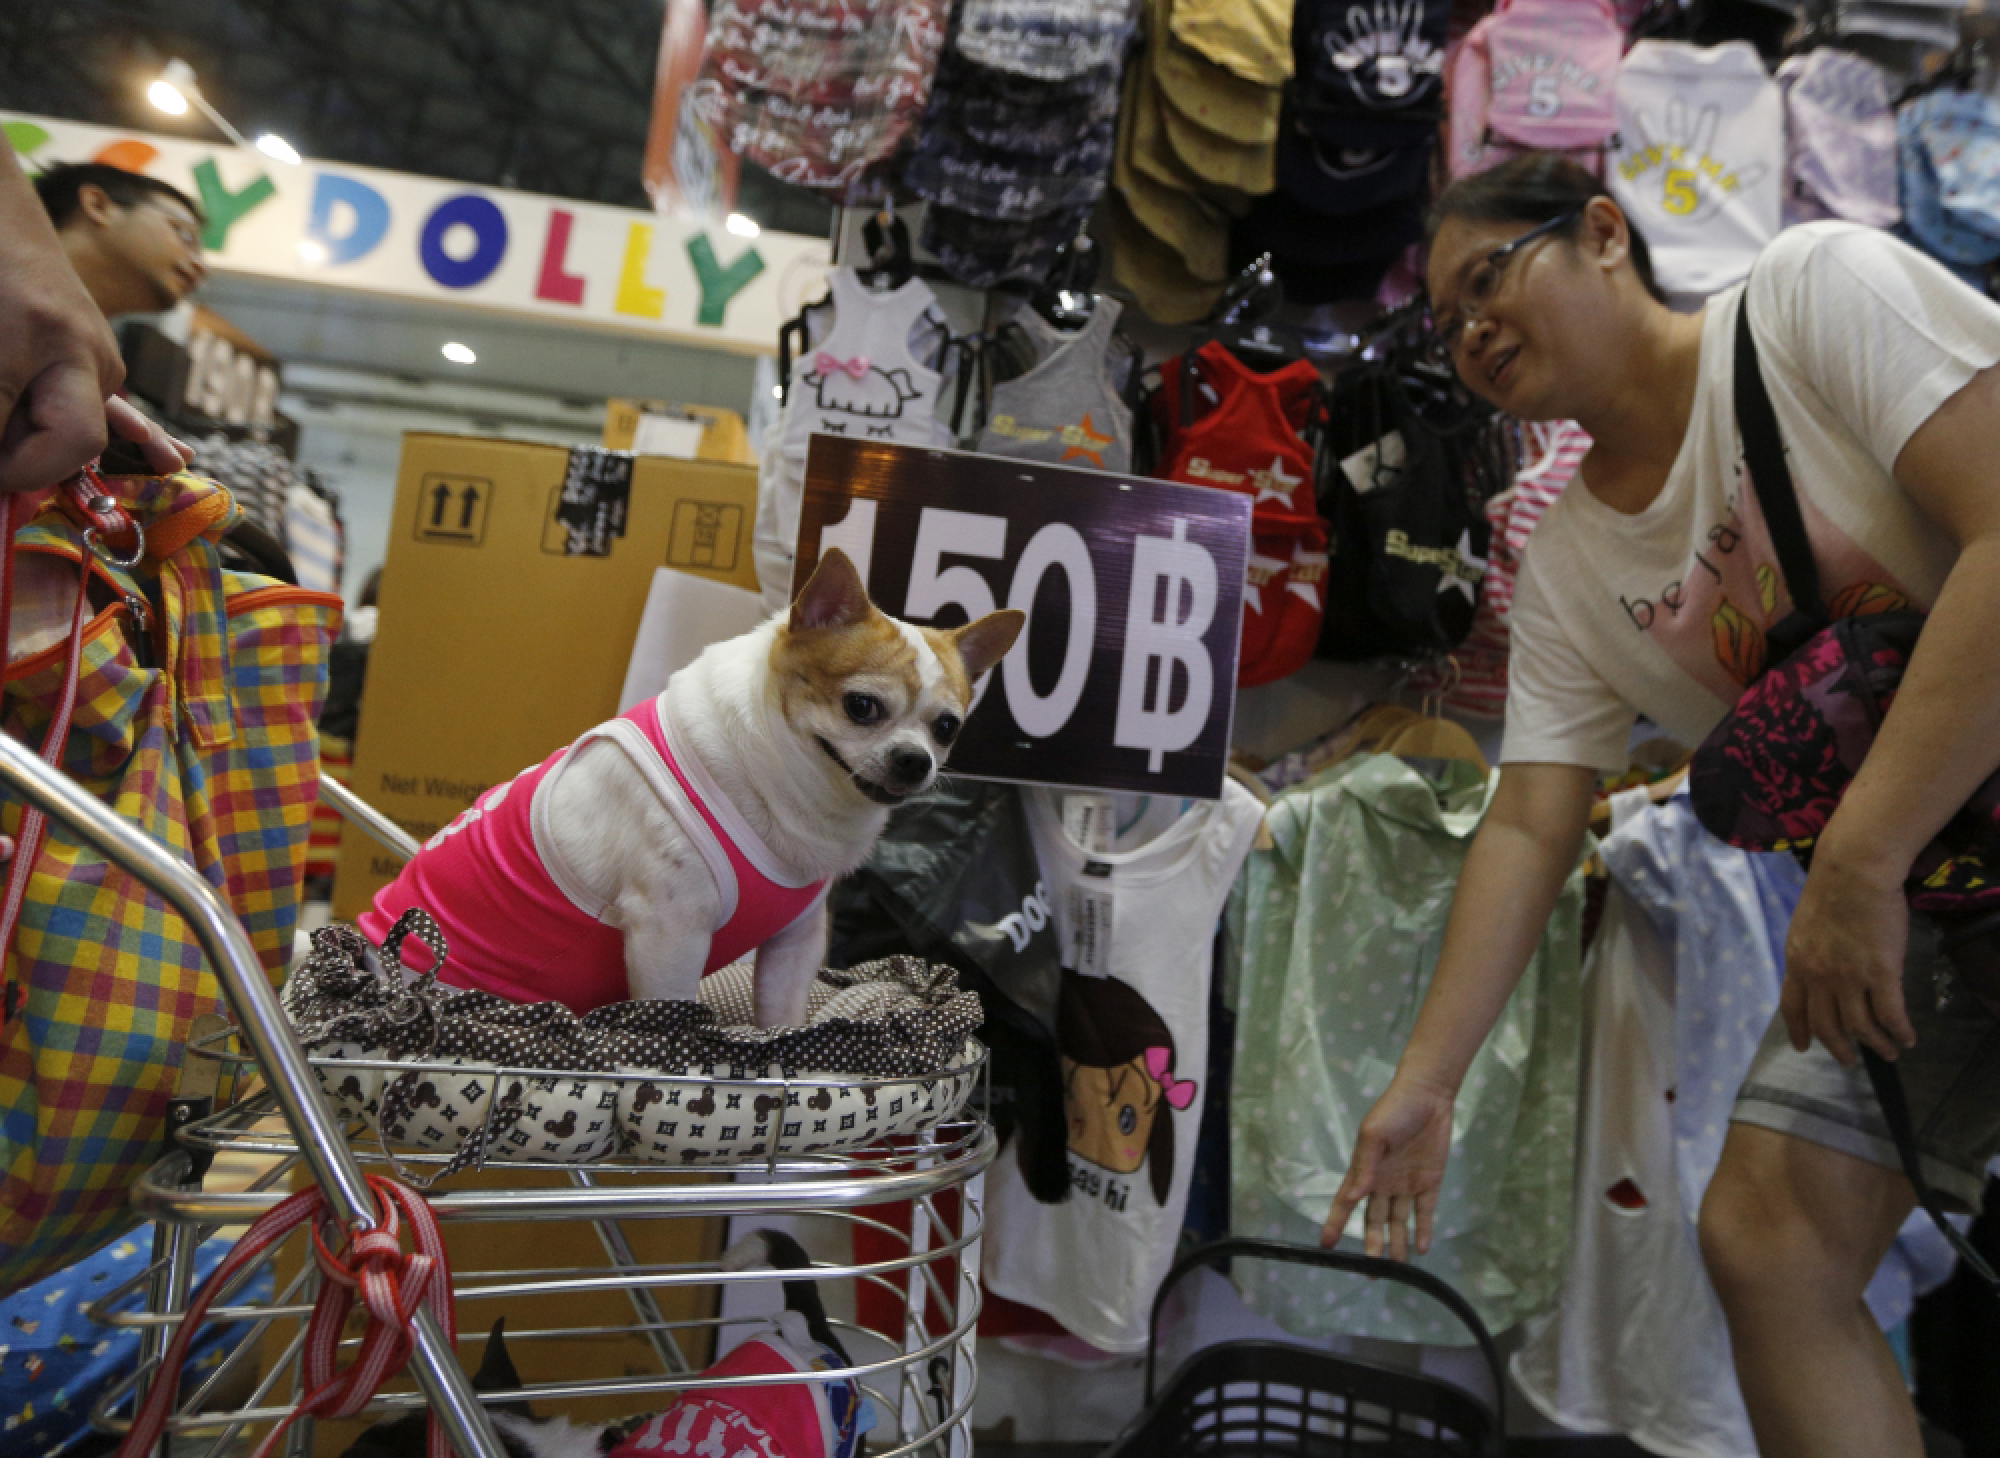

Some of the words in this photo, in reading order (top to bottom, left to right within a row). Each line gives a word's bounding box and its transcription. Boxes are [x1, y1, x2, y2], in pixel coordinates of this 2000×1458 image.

[1528, 76, 1562, 118] 5
[1662, 168, 1699, 216] 5
[380, 773, 418, 794] Net
[1103, 1179, 1131, 1212] hi
